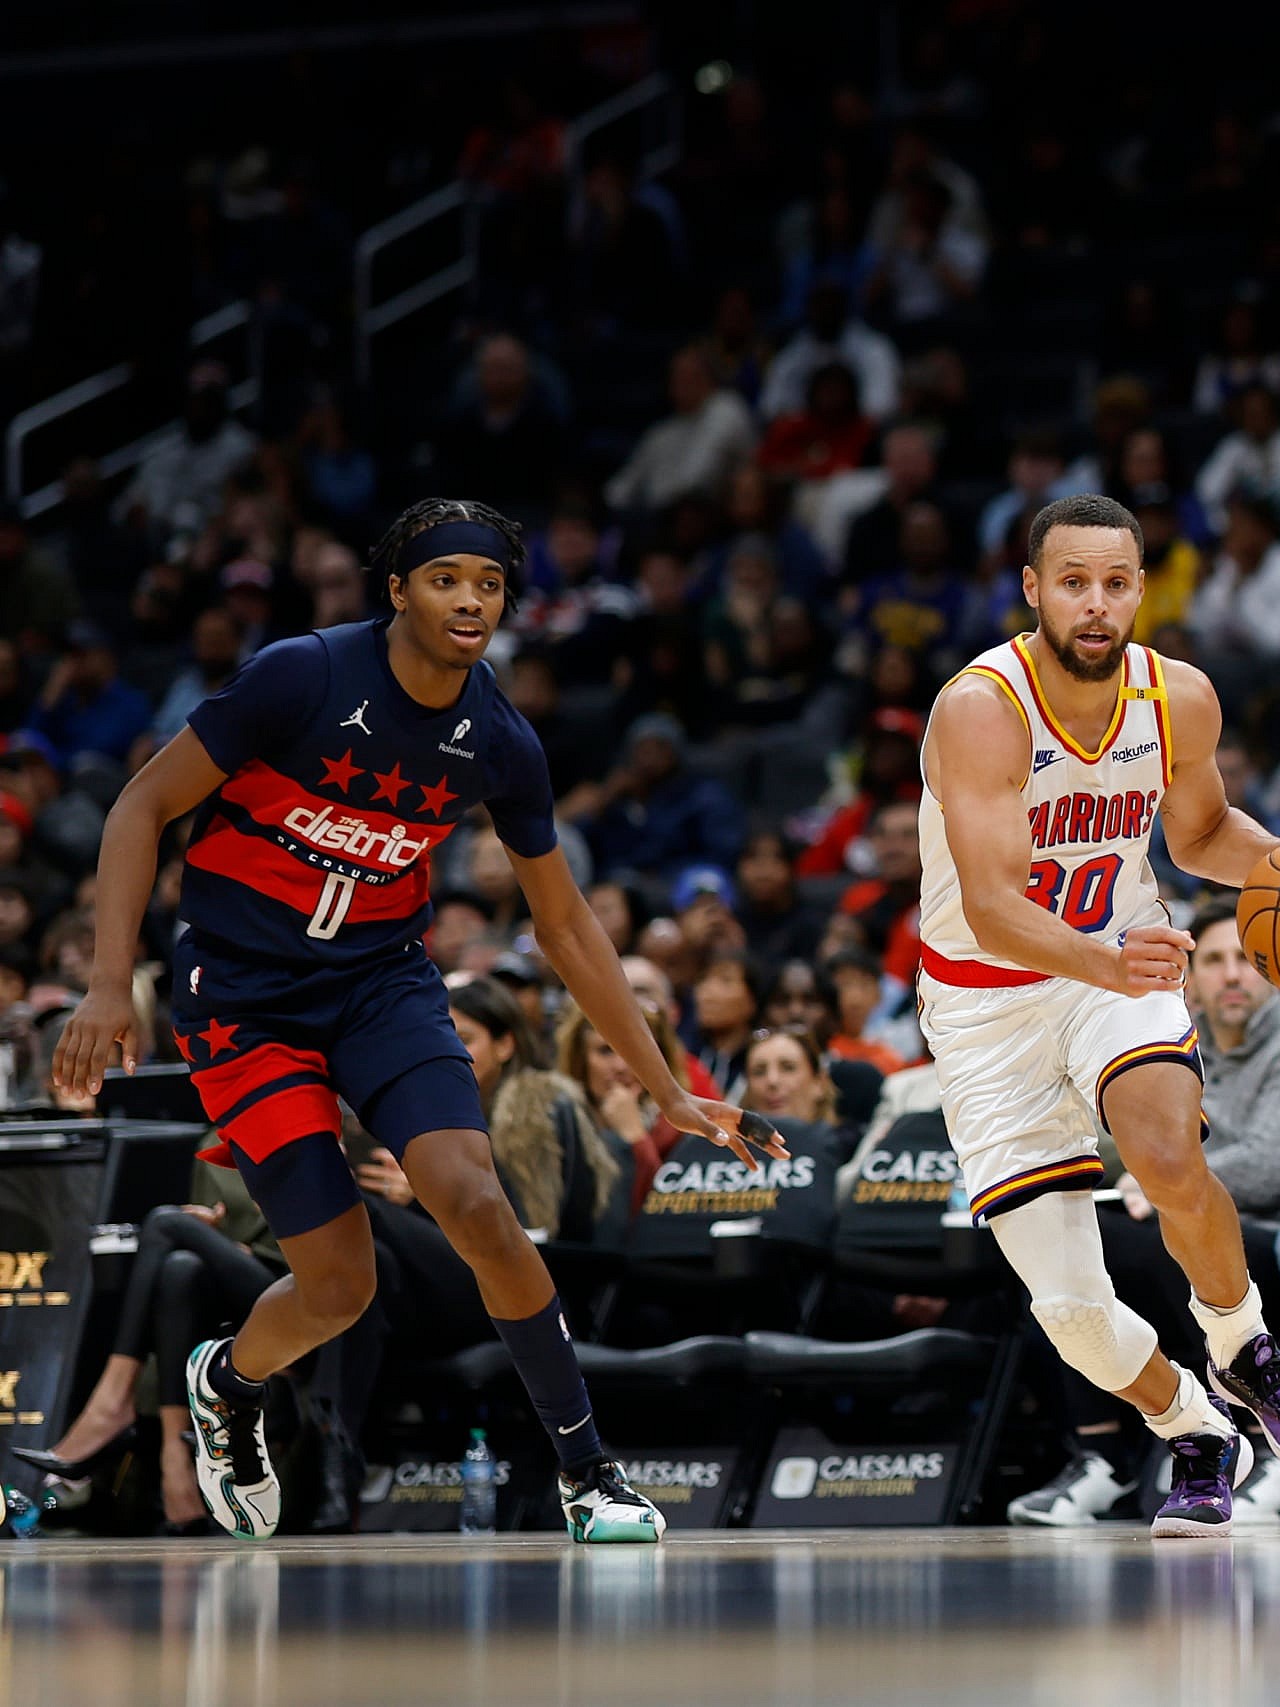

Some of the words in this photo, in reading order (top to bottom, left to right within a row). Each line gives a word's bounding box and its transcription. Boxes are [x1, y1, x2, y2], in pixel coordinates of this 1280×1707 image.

[439, 742, 475, 760] Robinhood
[1035, 750, 1057, 764] NIKE
[1112, 741, 1159, 763] Rakuten
[1028, 790, 1158, 849] ARRIORS
[308, 853, 399, 885] COLUM
[306, 872, 356, 940] 0
[1024, 853, 1124, 934] 30
[653, 1155, 816, 1194] CAESARS
[862, 1149, 959, 1183] CAES
[627, 1460, 723, 1489] AESARS
[819, 1453, 944, 1480] CAESARS
